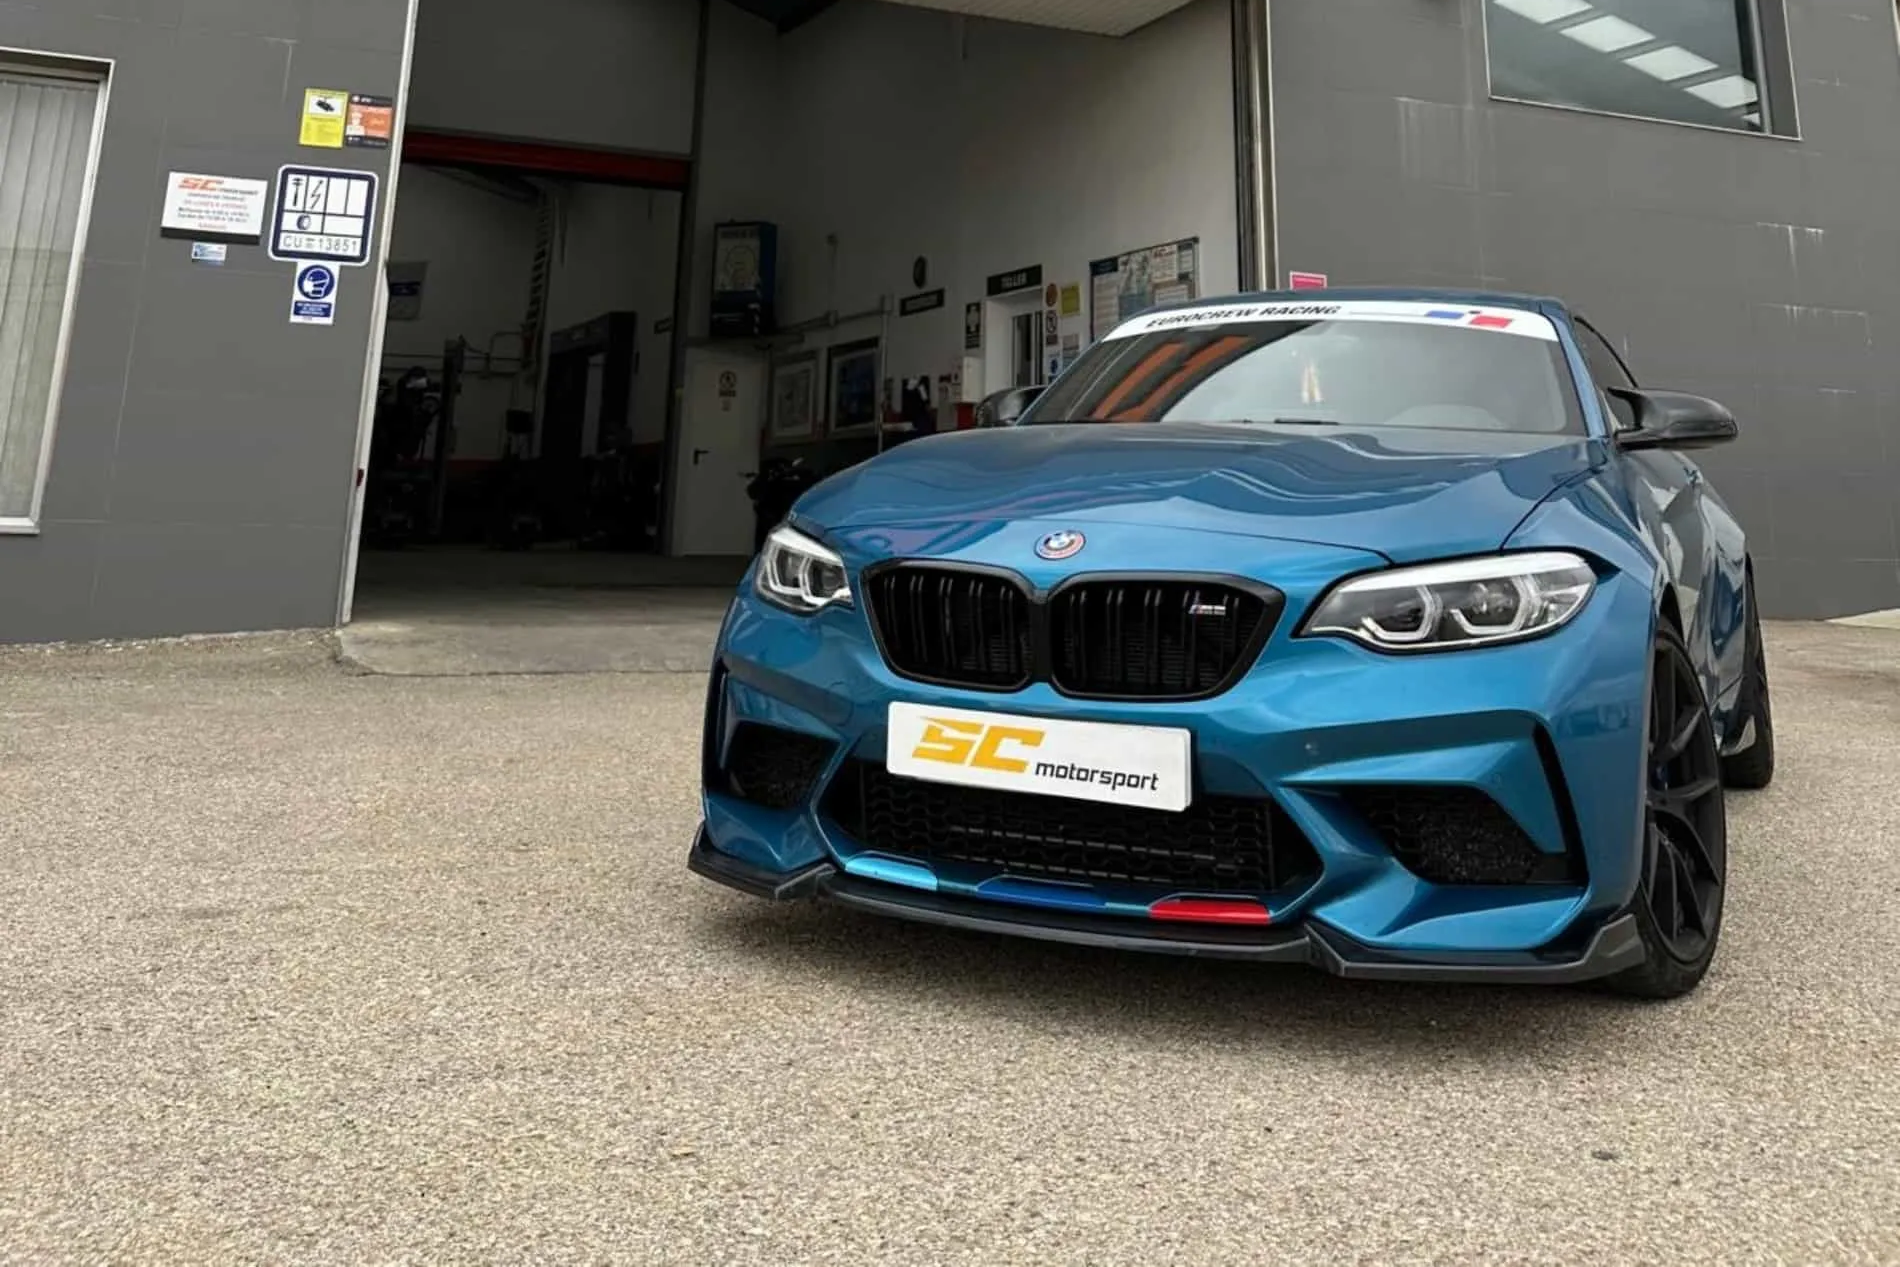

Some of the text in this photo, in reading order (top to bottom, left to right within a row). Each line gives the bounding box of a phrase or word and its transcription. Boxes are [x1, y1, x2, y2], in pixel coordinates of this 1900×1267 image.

[1146, 305, 1342, 329] EUROCREW RACING
[911, 716, 1160, 791] SC motorsport
